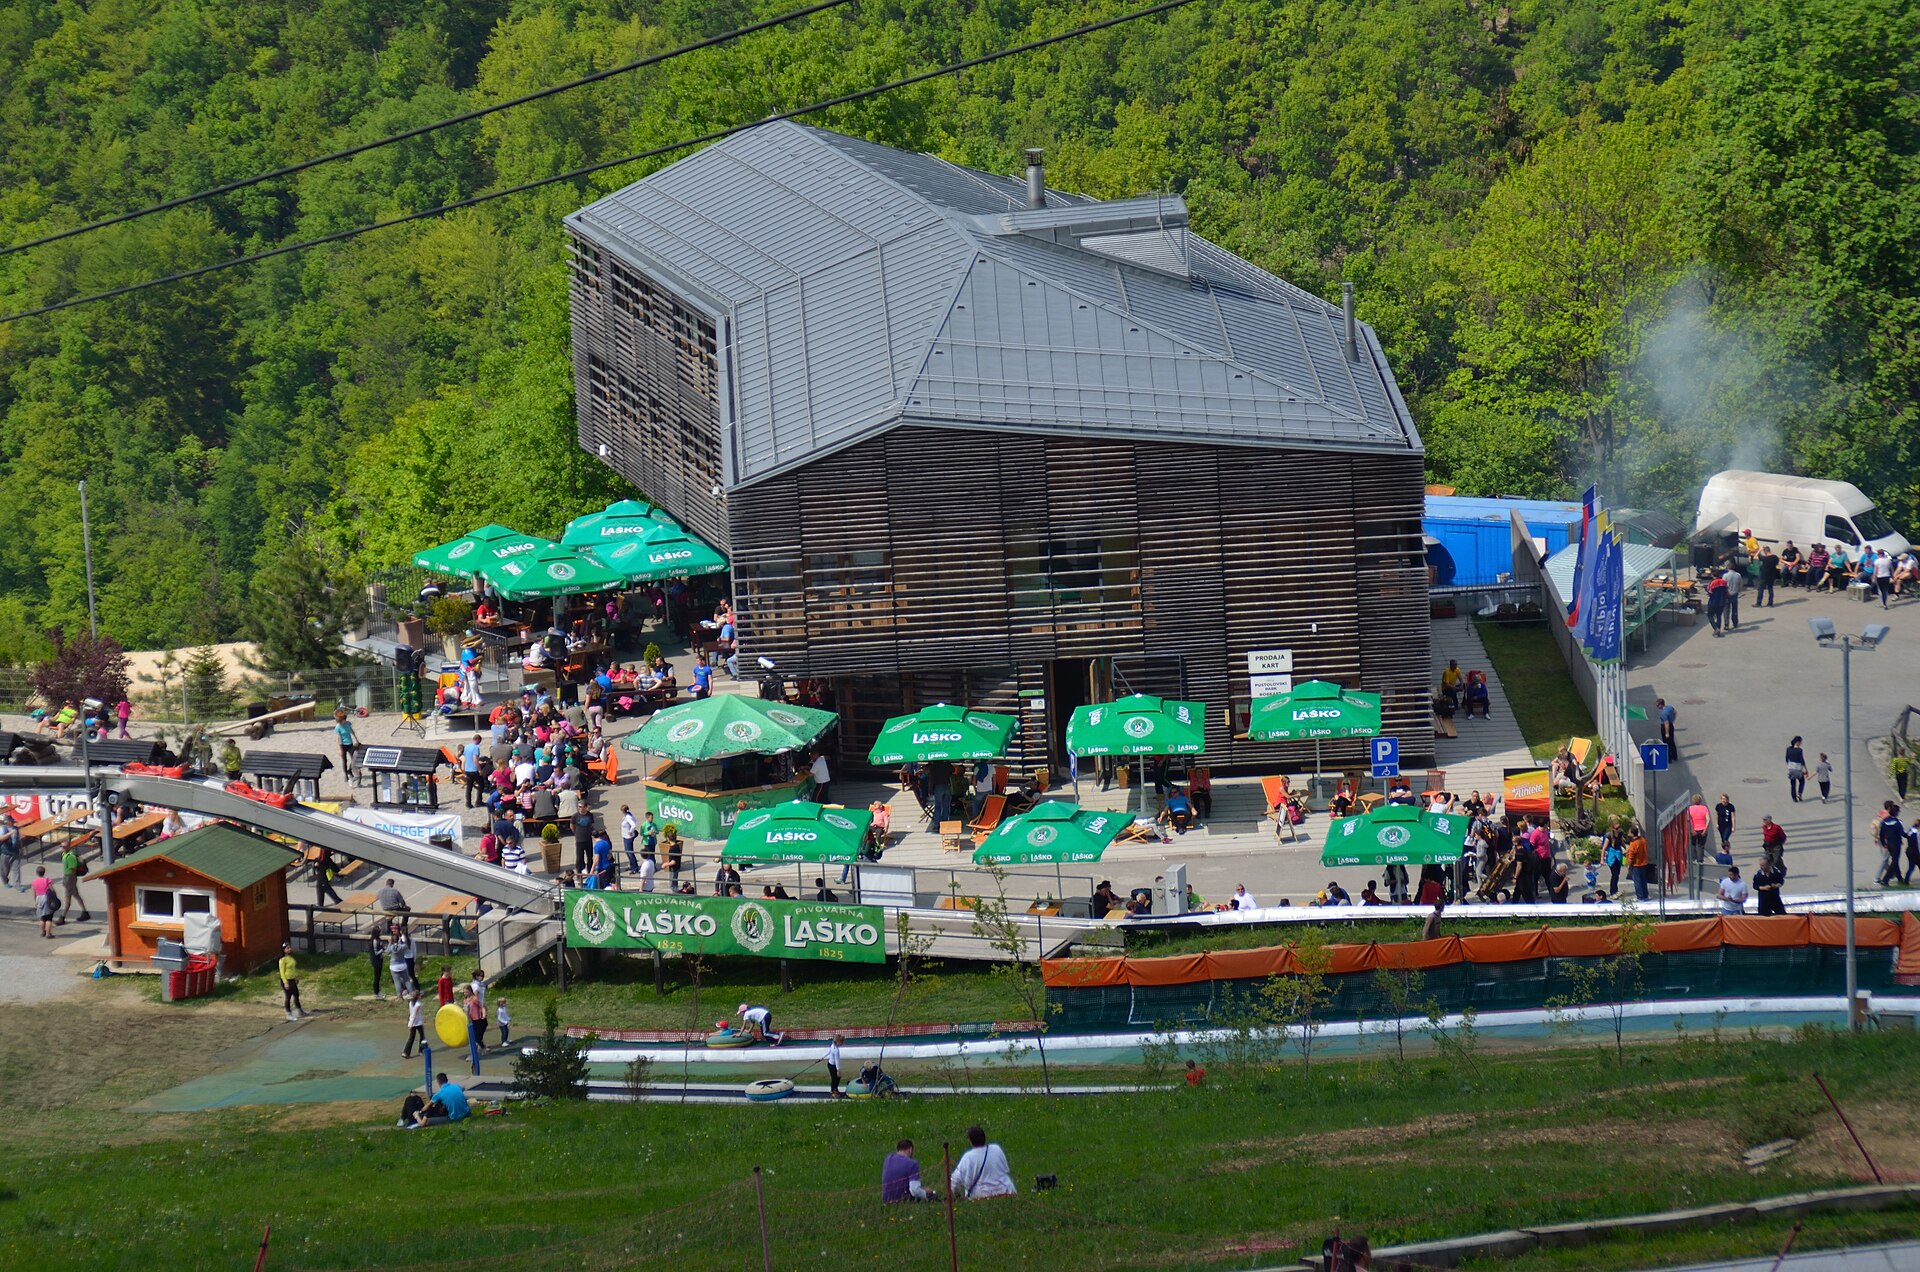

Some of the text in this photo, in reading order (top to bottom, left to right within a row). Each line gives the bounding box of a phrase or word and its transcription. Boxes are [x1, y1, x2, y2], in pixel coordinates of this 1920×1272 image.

[1292, 710, 1341, 721] LAŠKO
[912, 732, 963, 745] LAŠKO
[1376, 741, 1392, 761] P
[659, 802, 694, 822] LAŠKO
[766, 831, 818, 844] LAŠKO
[634, 897, 704, 911] PIVOVARNA
[795, 905, 865, 919] PIVOVARNA
[623, 907, 717, 938] LAŠKO
[783, 914, 878, 948] LAŠKO
[656, 940, 684, 951] 1825
[818, 947, 844, 960] 1825
